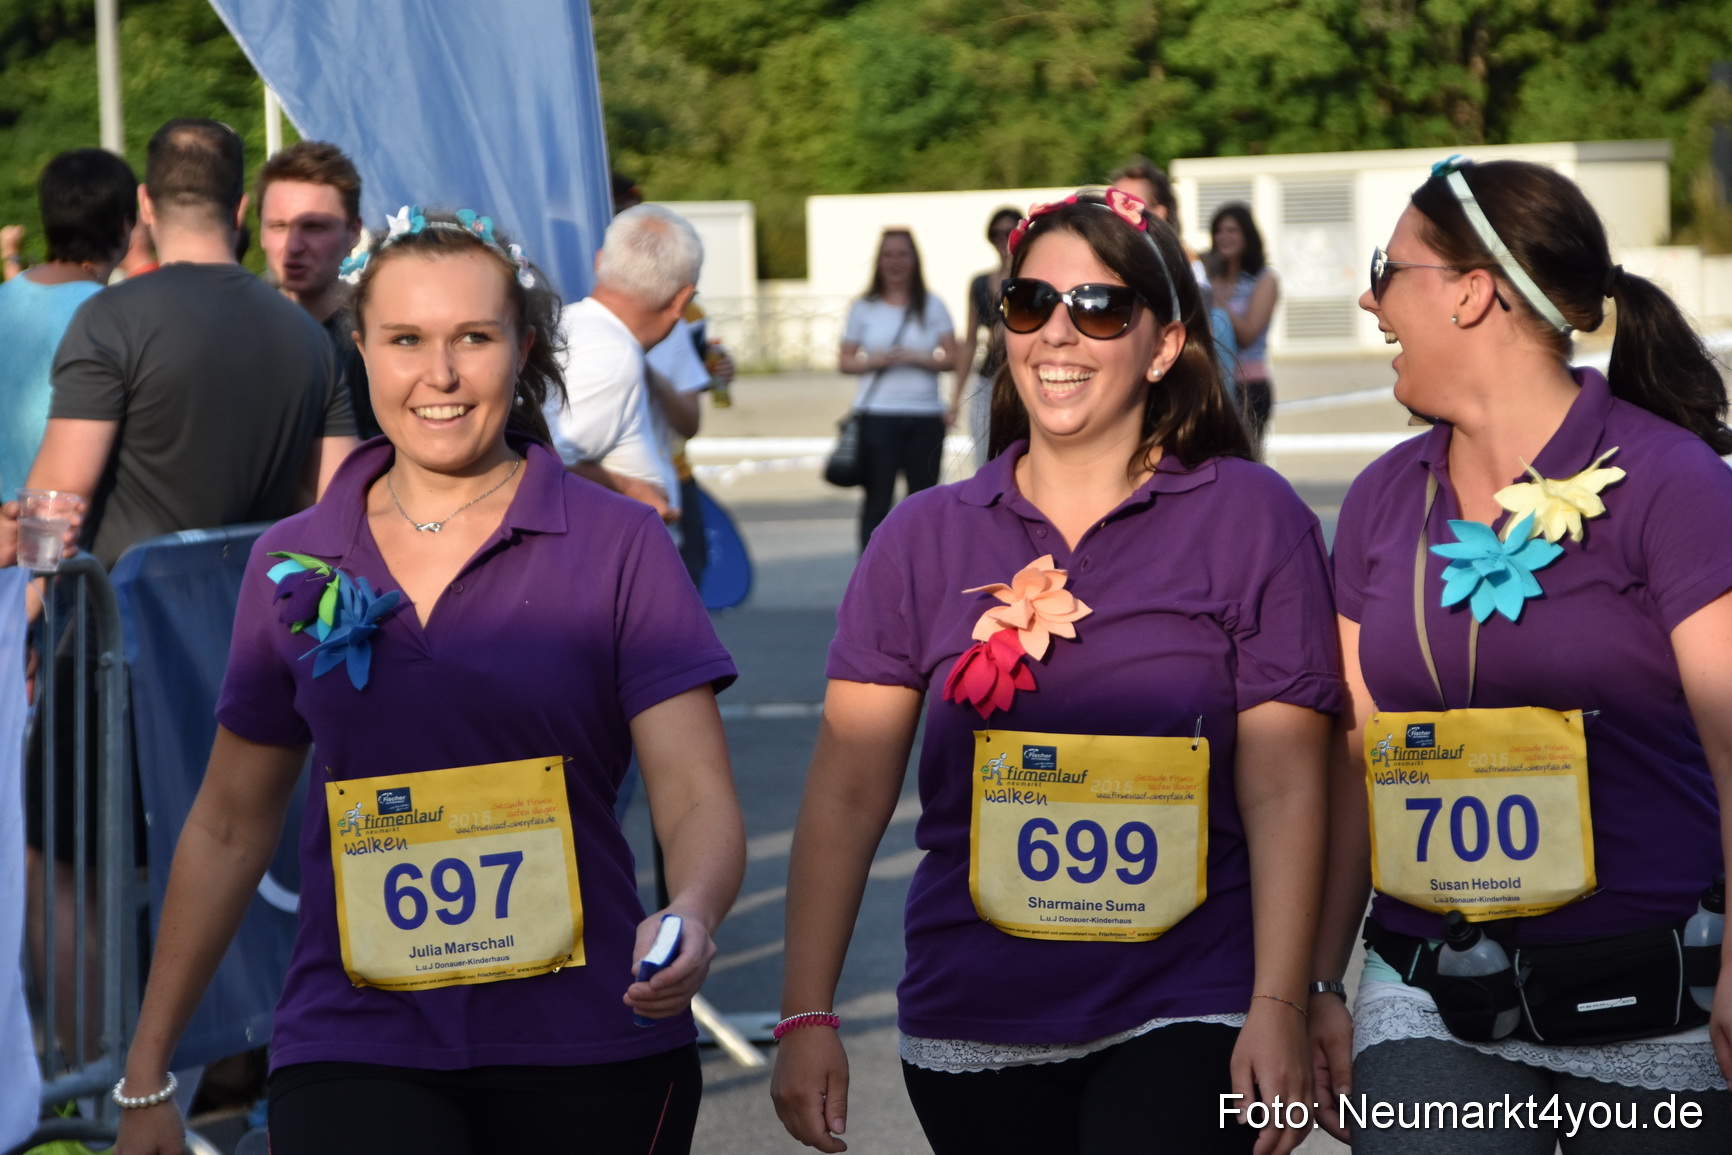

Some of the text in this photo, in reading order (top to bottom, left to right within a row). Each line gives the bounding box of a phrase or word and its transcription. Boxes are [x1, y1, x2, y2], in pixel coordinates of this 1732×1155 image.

[1411, 729, 1431, 737] Fischer
[1028, 751, 1053, 759] Fischer
[1393, 744, 1465, 760] firmenlauf
[1468, 752, 1509, 768] 2015
[1007, 766, 1088, 784] firmenlauf
[1375, 768, 1431, 785] walken
[1006, 780, 1042, 788] neumarkt
[1090, 779, 1134, 794] 2015
[382, 794, 406, 802] Fischer
[984, 788, 1048, 805] walken
[365, 806, 444, 829] firmenlauf
[448, 810, 492, 829] 2015
[365, 826, 400, 835] neumarkt
[1405, 794, 1540, 863] 700
[344, 836, 408, 856] walken
[1017, 817, 1158, 885] 699
[383, 850, 524, 931] 697
[1430, 877, 1521, 891] Susan Hebold
[1028, 896, 1146, 912] Sharmaine Suma
[1449, 895, 1520, 904] Donauer-Kinderhaus
[1059, 915, 1132, 925] Donauer-Kinderhaus
[408, 934, 515, 959] Julia Marschall
[415, 962, 433, 972] L.u.J
[434, 954, 510, 970] Donauer-Kinderhaus
[477, 969, 507, 978] Frischmann
